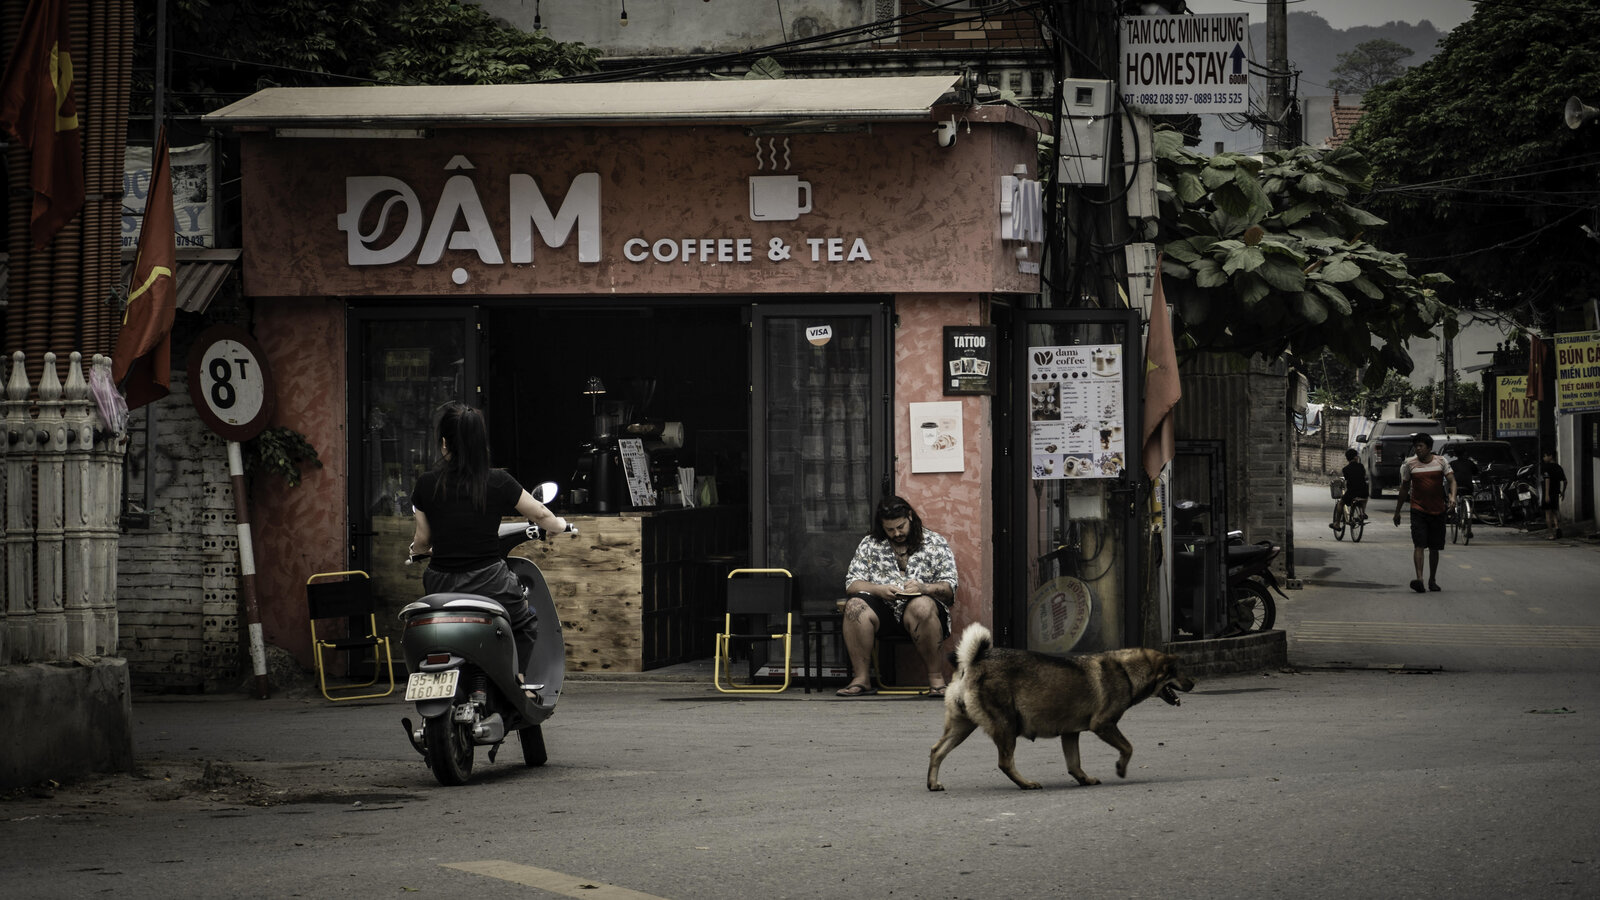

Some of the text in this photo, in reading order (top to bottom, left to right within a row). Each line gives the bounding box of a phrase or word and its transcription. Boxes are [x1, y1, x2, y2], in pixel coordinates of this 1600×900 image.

[1127, 16, 1243, 44] TAM COC MINH HUNG
[1126, 51, 1228, 86] HOMESTAY
[1140, 93, 1158, 105] 0982
[1160, 93, 1173, 105] 038
[1175, 93, 1188, 104] 597
[1194, 93, 1212, 104] 0889
[1214, 93, 1227, 104] 135
[1229, 92, 1243, 104] 525
[623, 237, 872, 263] COFFEE & TEA
[809, 328, 829, 337] VISA
[1556, 334, 1590, 344] RESTAURANT
[953, 335, 986, 348] TATTOO
[1055, 356, 1085, 365] coffee
[1559, 344, 1584, 365] BÚN
[1522, 397, 1536, 419] XE
